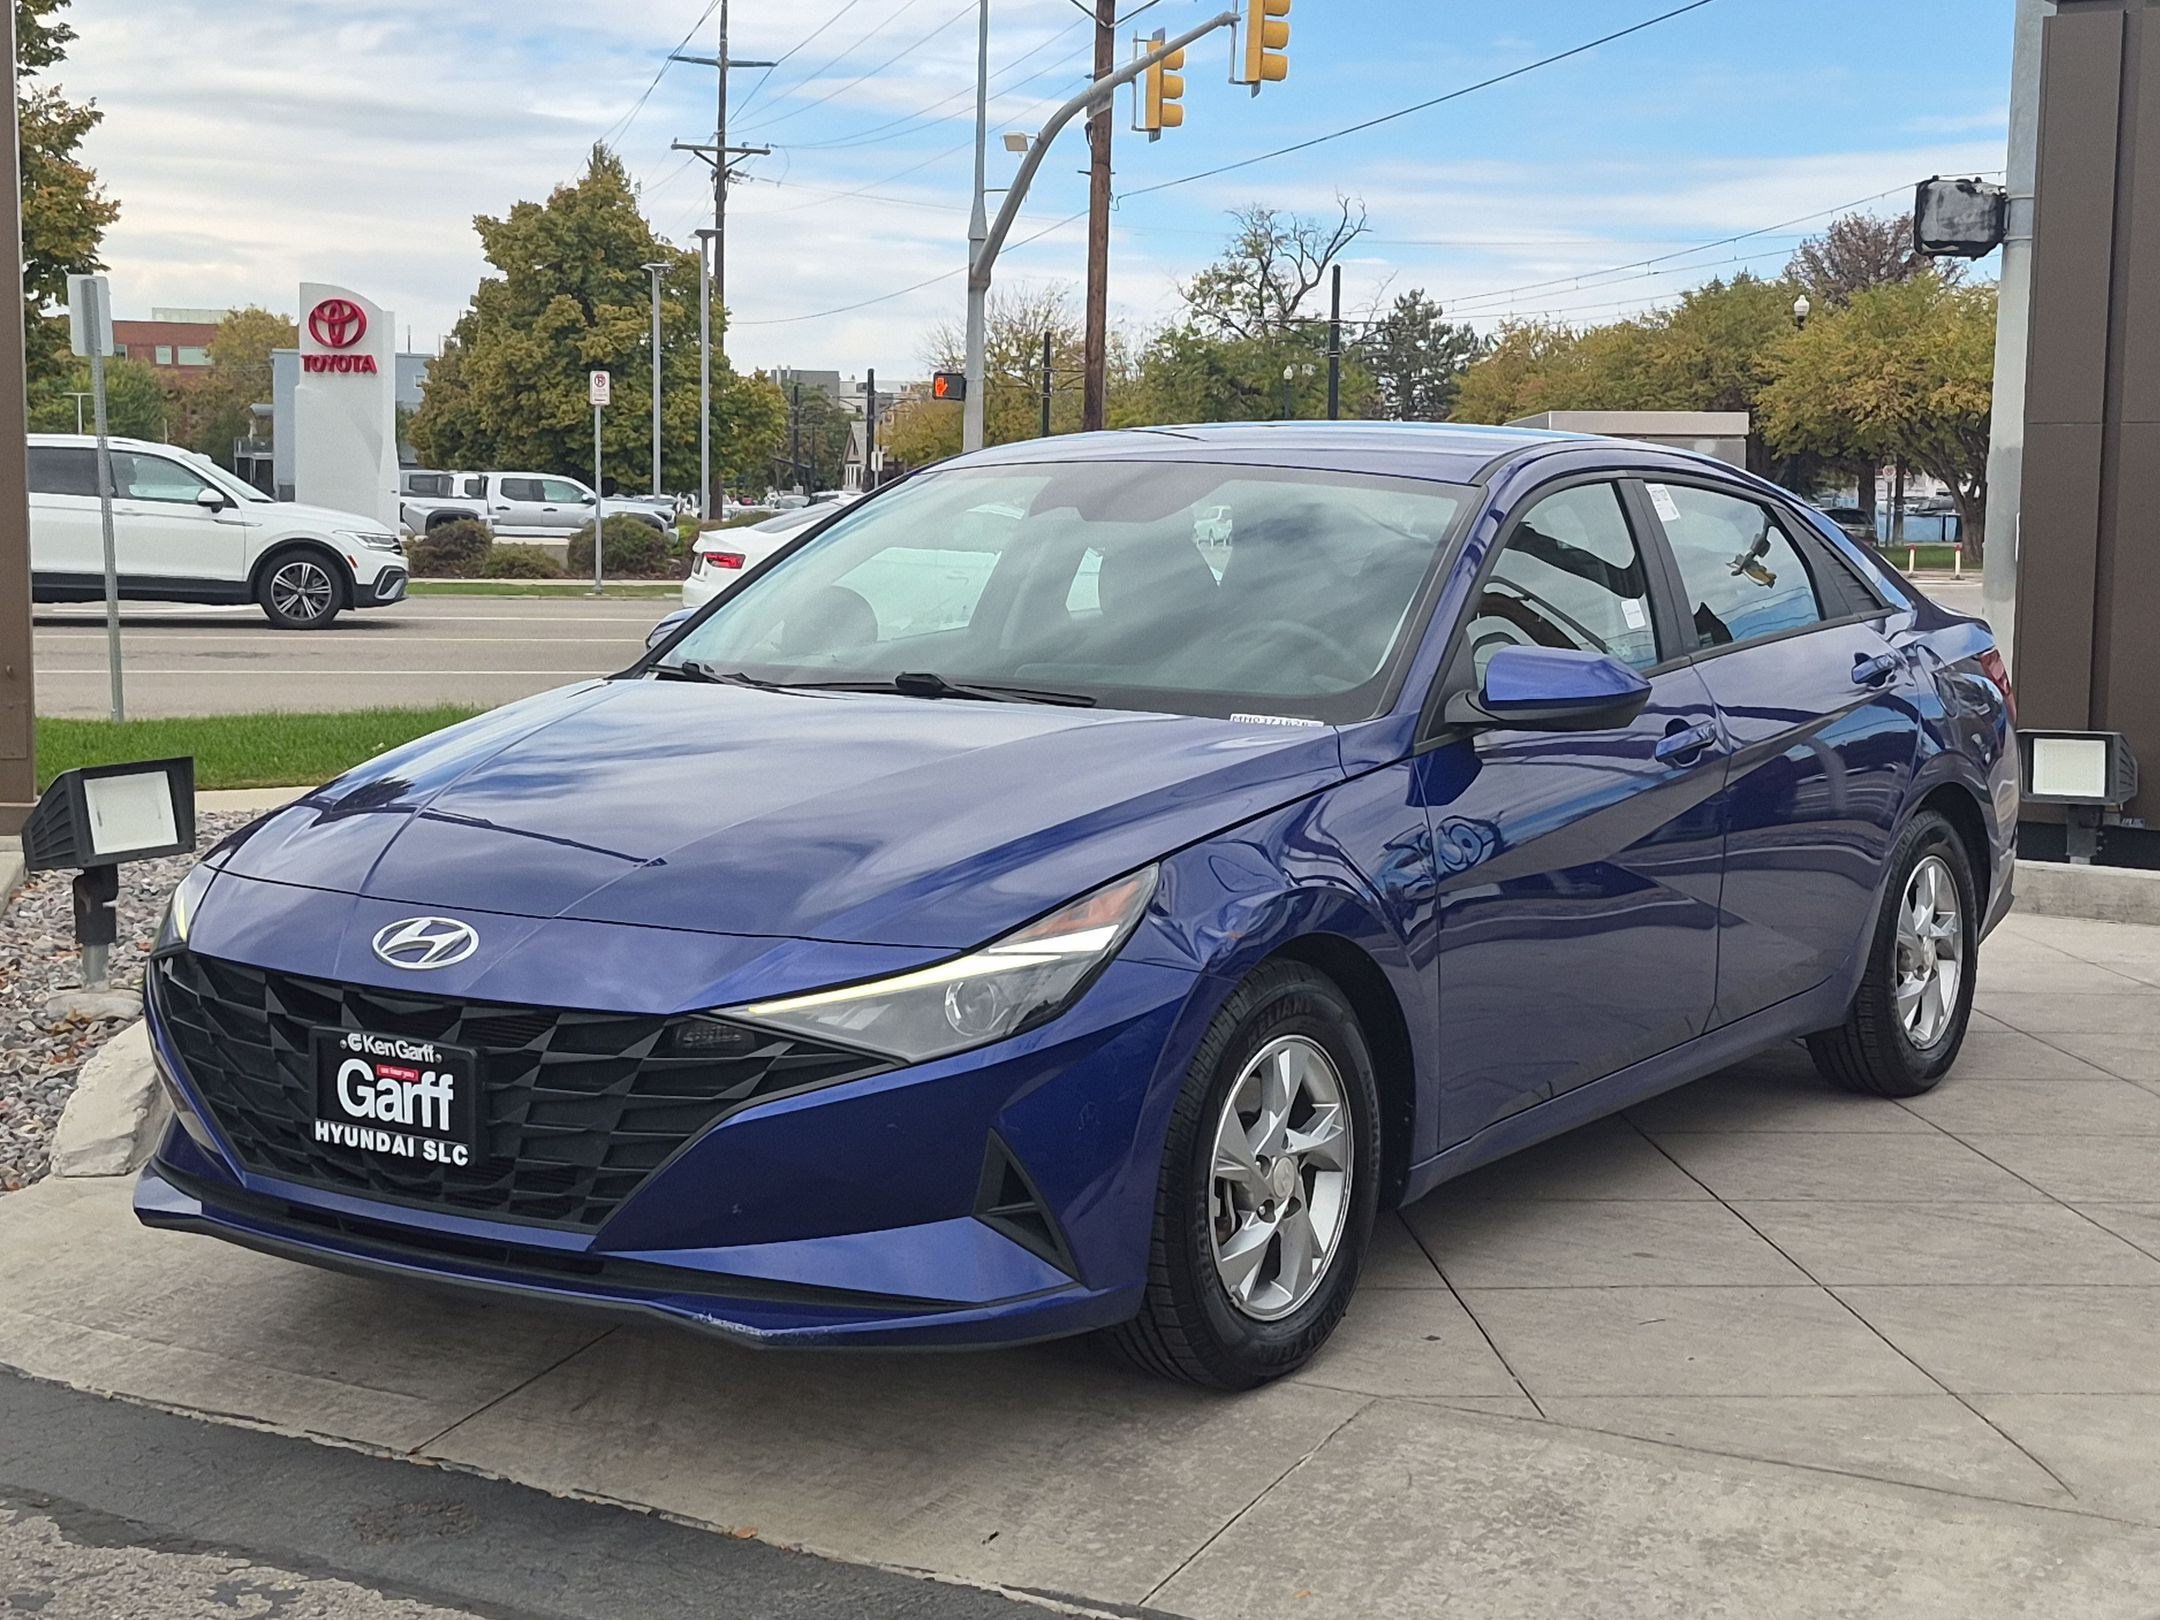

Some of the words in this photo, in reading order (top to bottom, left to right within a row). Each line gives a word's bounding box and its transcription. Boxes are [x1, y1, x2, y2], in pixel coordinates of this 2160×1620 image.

[301, 354, 377, 375] TOYOTA
[362, 1034, 396, 1058] Ken
[395, 1039, 435, 1064] Garff
[337, 1058, 454, 1131] Garff
[315, 1120, 415, 1158] HYUNDAI
[422, 1139, 469, 1167] SLC
